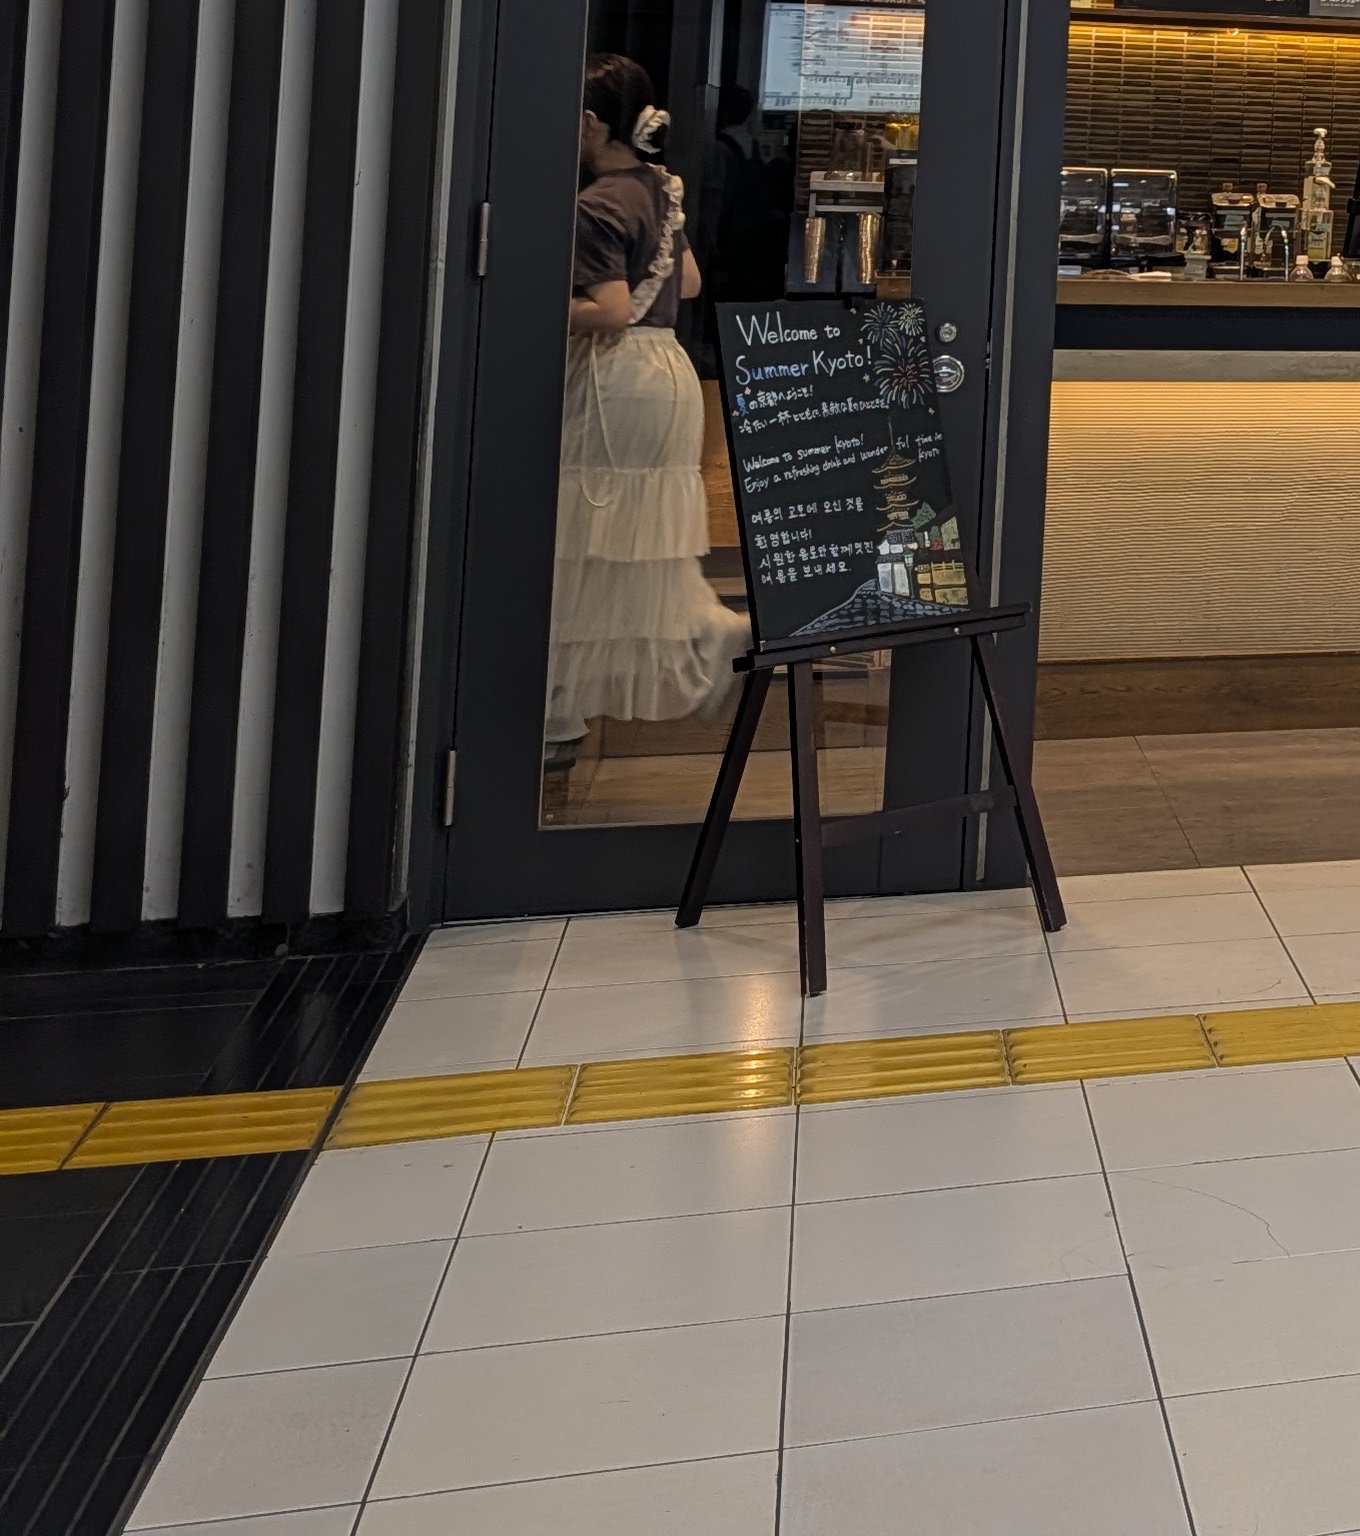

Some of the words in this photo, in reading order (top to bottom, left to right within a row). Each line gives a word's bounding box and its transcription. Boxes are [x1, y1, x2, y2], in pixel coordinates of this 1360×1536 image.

[736, 311, 818, 346] Welcome
[824, 325, 840, 339] to
[736, 355, 809, 386] Summer
[813, 345, 871, 377] Kyoto!
[782, 452, 792, 462] to
[744, 476, 769, 493] Enjoy
